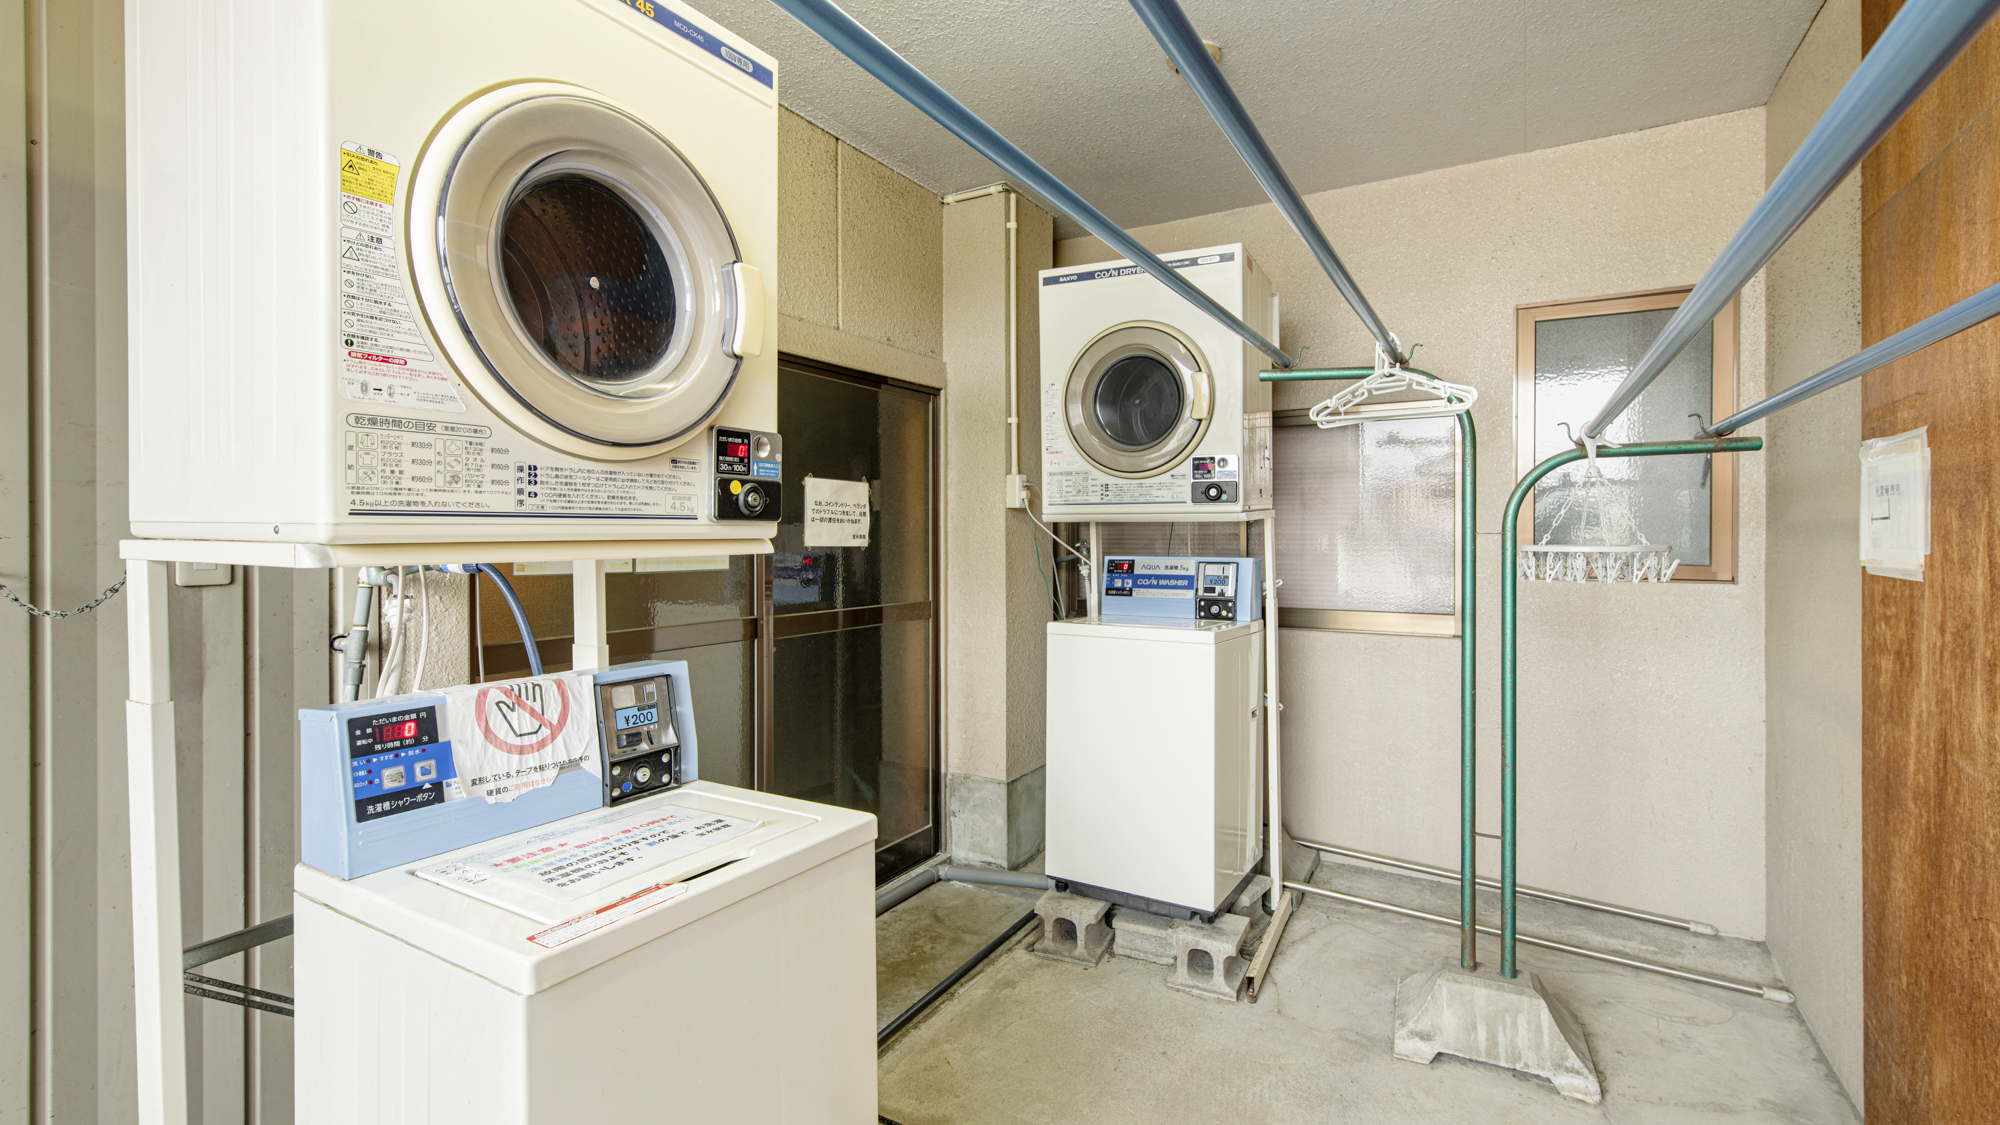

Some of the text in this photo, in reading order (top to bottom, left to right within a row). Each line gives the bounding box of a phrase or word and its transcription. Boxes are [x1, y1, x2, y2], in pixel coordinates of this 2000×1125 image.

[636, 0, 654, 18] 45
[674, 20, 704, 42] MCD-CK45
[724, 49, 750, 71] 100V専用
[367, 148, 383, 160] 警告
[368, 235, 383, 244] 注意
[1095, 269, 1118, 279] COIN
[354, 416, 437, 432] 乾燥時間の目安
[350, 500, 490, 508] 4.5kg以上の洗濯物を入れないでください。
[1137, 577, 1157, 585] COIN
[373, 714, 417, 726] ただいまの金額
[624, 712, 653, 726] ¥200
[366, 792, 435, 815] 洗濯槽シャワーボタン
